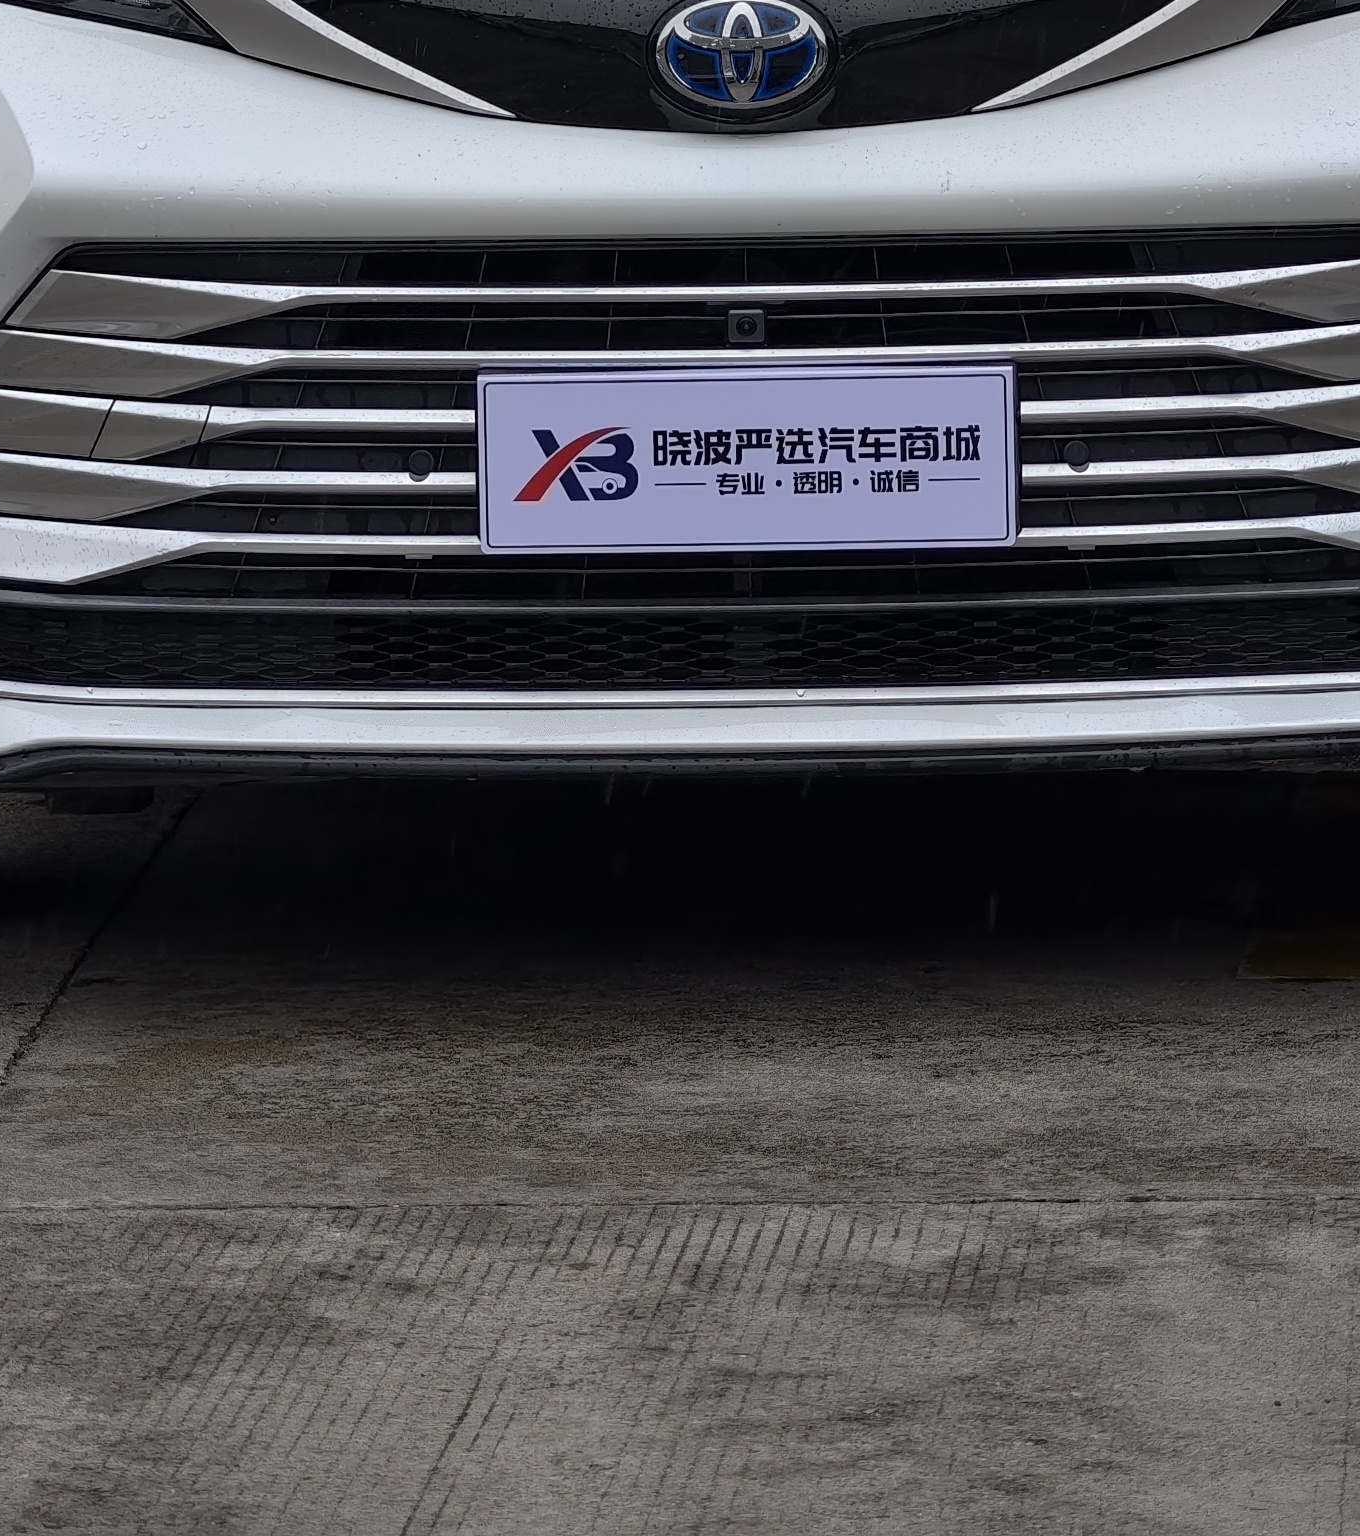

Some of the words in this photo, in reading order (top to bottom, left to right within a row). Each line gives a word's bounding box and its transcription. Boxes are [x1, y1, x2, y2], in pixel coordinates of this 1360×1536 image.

[652, 425, 981, 466] 晓波严选汽车商城
